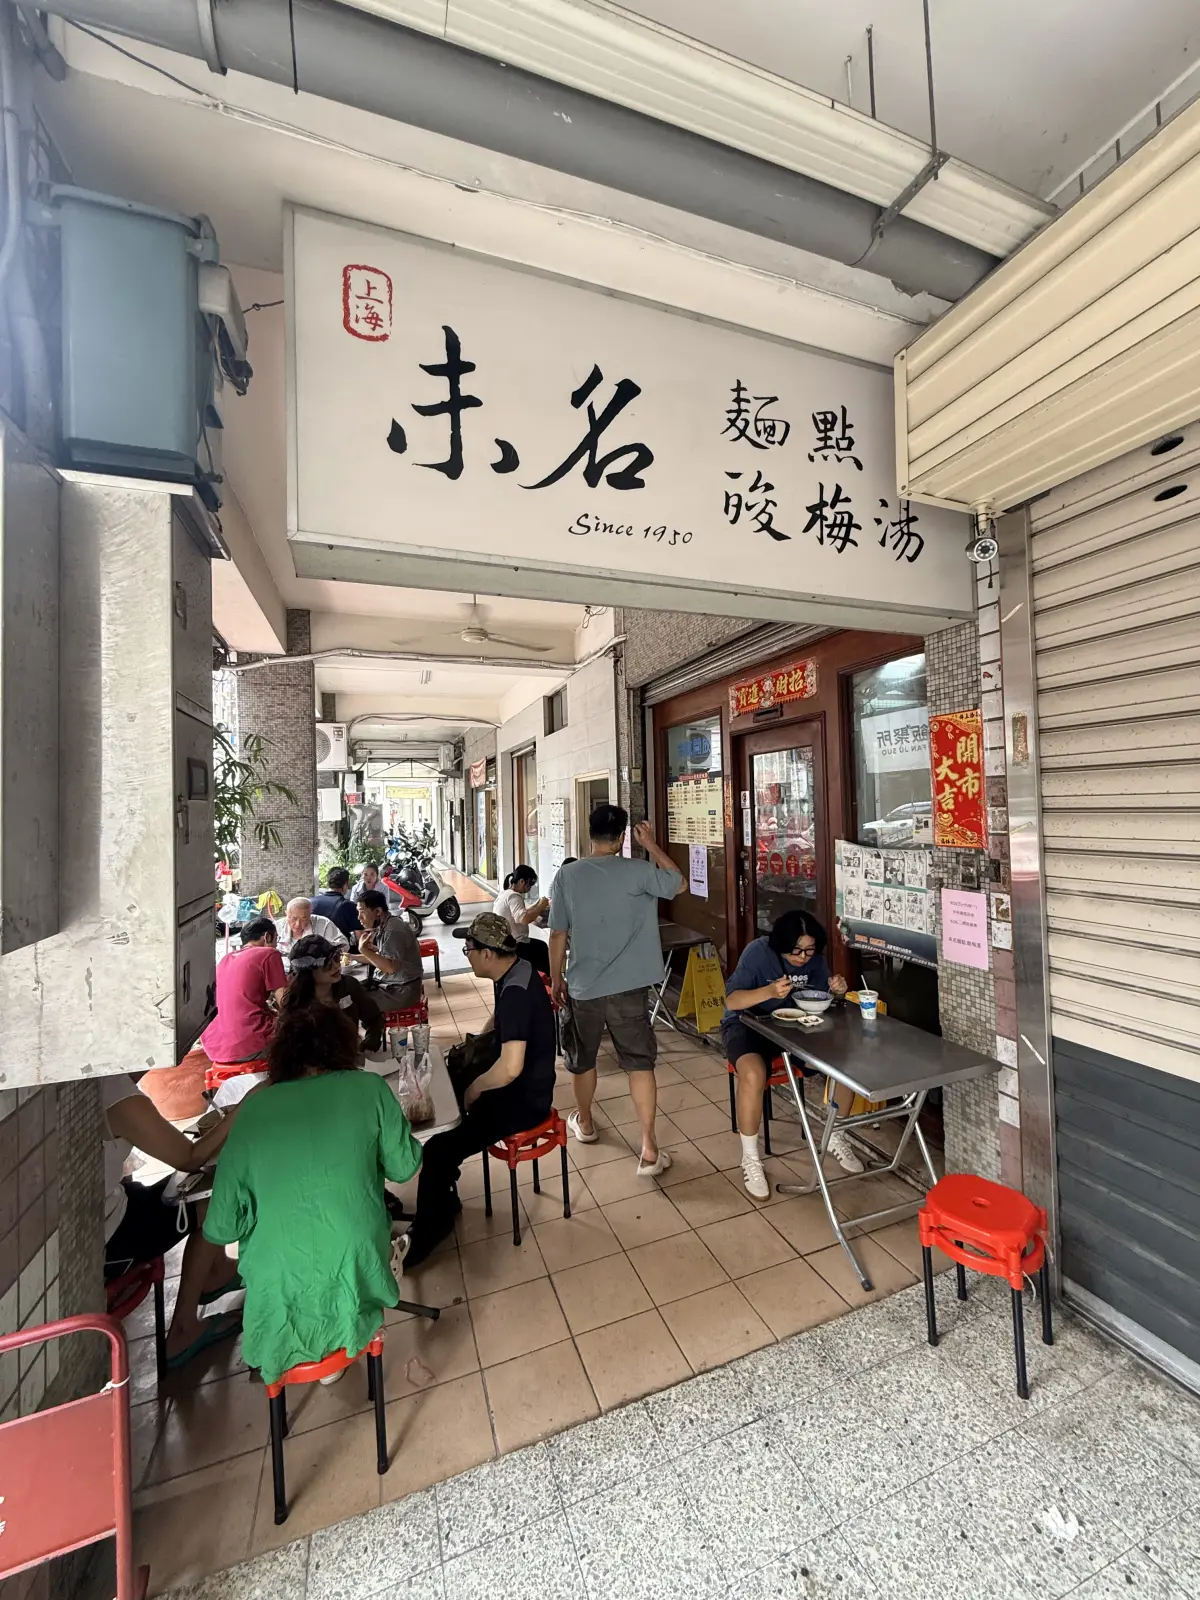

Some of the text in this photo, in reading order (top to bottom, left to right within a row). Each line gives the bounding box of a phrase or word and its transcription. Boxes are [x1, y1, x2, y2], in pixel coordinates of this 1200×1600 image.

[354, 278, 383, 333] 上海
[386, 325, 654, 491] 未名
[720, 379, 863, 471] 麵點
[568, 513, 693, 546] Since 1950
